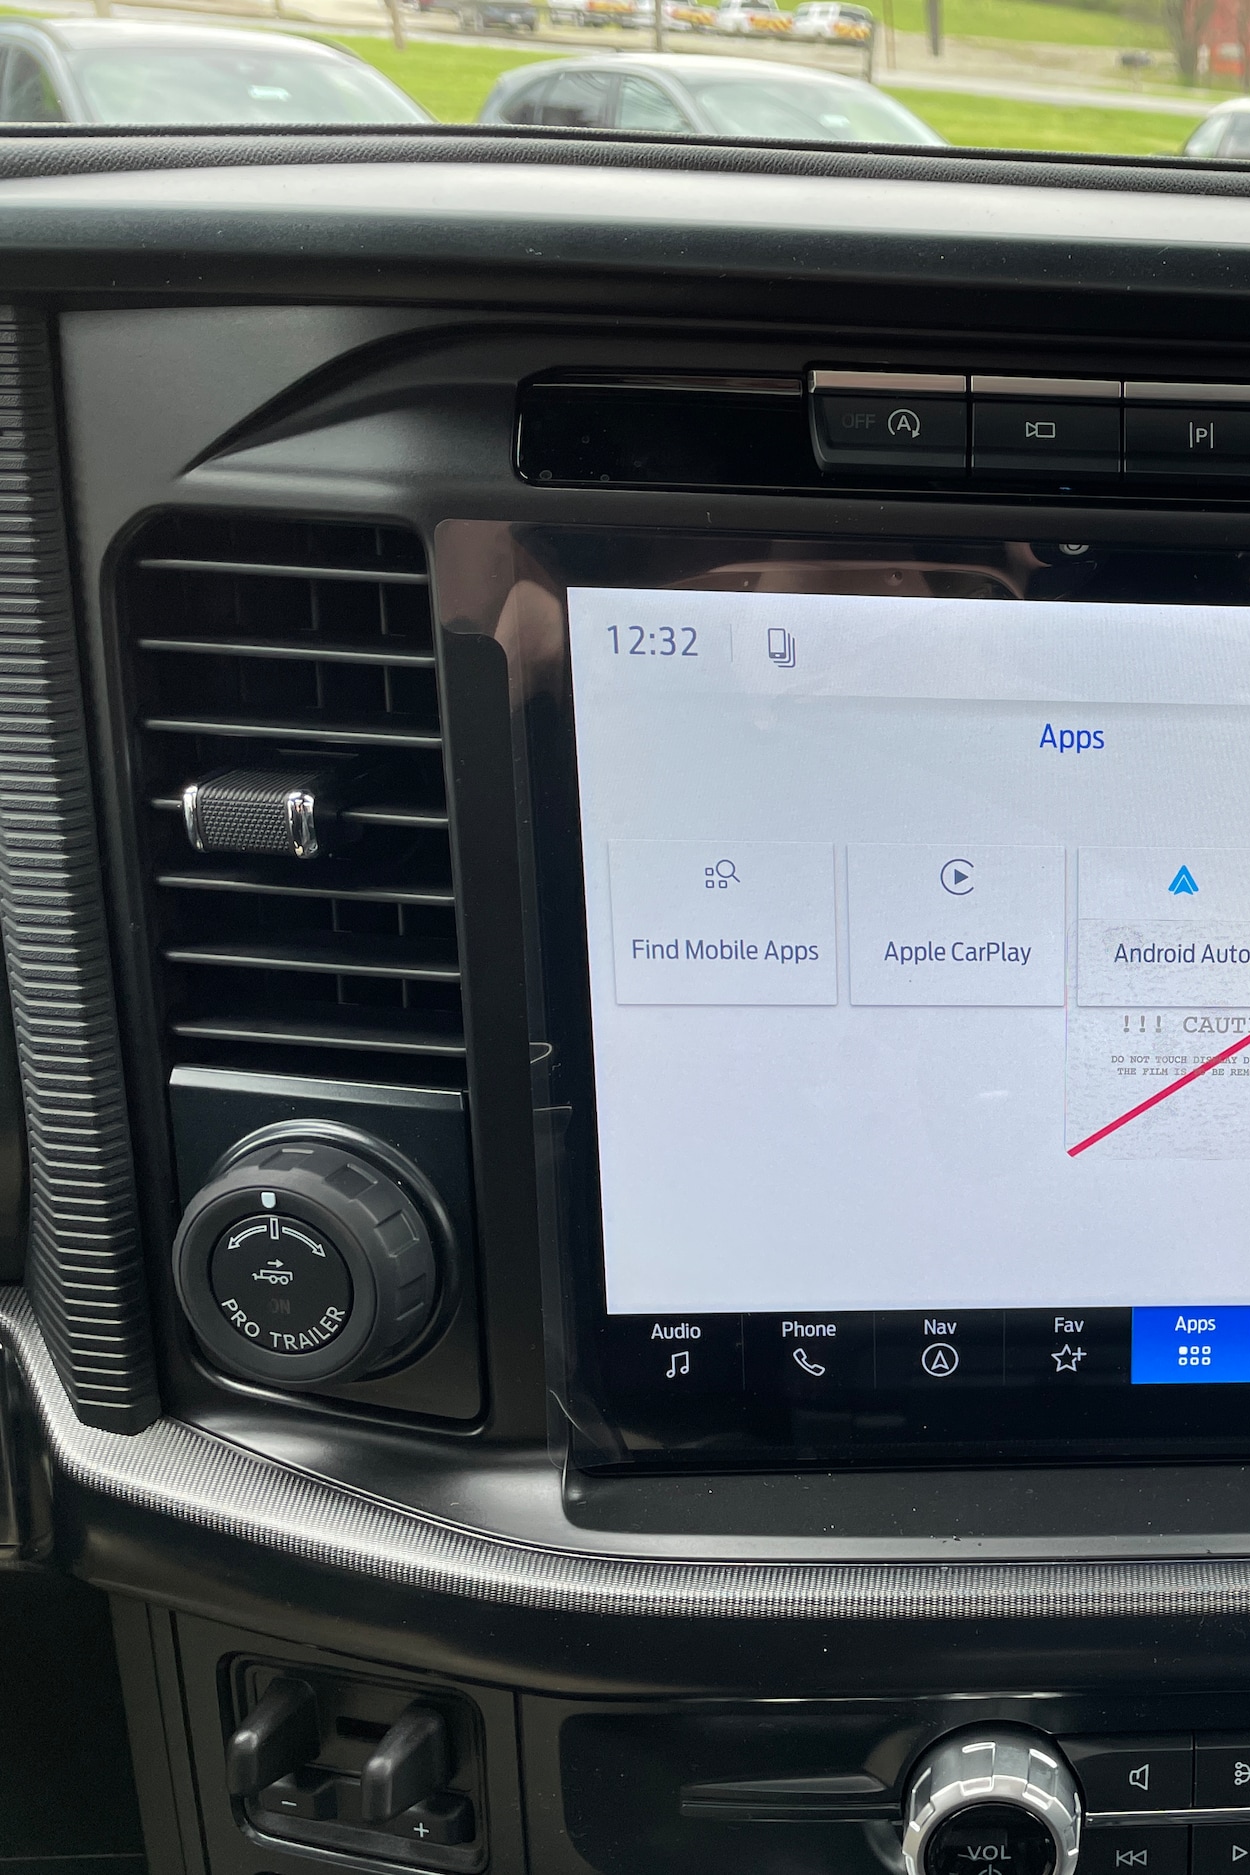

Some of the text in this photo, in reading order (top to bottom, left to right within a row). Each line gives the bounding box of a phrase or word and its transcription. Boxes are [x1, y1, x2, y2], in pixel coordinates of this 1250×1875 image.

[841, 413, 876, 429] OFF
[606, 625, 699, 657] 12:32
[1039, 723, 1105, 754] Apps
[631, 938, 819, 967] Find Mobile Apps
[884, 939, 1032, 967] Apple CarPlay
[1114, 942, 1250, 965] Android Auto
[1155, 1056, 1187, 1064] TOUCH
[1193, 1056, 1238, 1064] DISAY
[1117, 1067, 1137, 1076] THE
[1142, 1067, 1169, 1076] FILM
[1174, 1067, 1187, 1076] IS
[1212, 1068, 1225, 1076] BE
[221, 1298, 346, 1350] PRO TRAILER
[651, 1322, 702, 1341] Audio
[781, 1320, 837, 1339] Phone
[924, 1319, 957, 1336] Nav
[1053, 1317, 1085, 1334] Fav
[1174, 1315, 1217, 1335] Apps
[967, 1844, 1011, 1860] VOL
